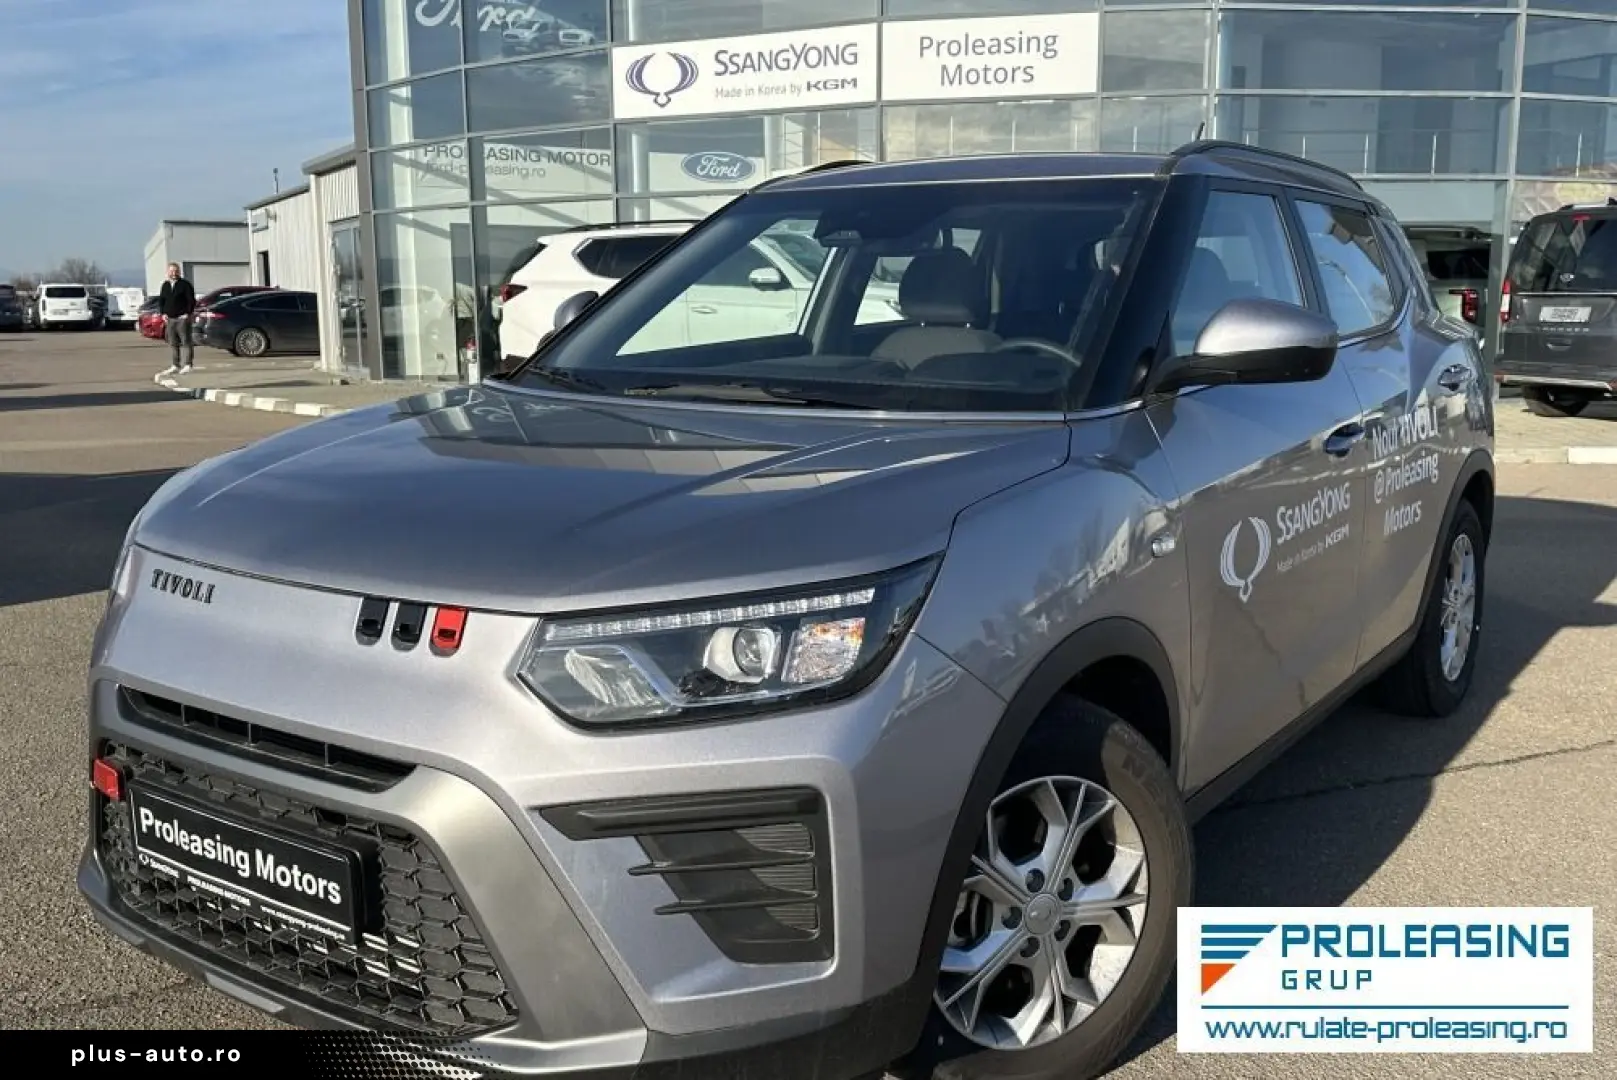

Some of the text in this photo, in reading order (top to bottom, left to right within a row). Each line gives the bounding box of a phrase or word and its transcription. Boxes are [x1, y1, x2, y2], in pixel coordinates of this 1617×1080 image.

[919, 30, 1059, 60] Proleasing
[715, 77, 859, 99] Made in Korea by KGM
[940, 64, 1035, 87] Motors
[696, 154, 742, 178] Ford
[1398, 404, 1438, 447] TIVOLI
[1383, 500, 1422, 537] Motors
[1325, 523, 1351, 549] KGM
[150, 568, 216, 604] TIVOLI
[138, 805, 250, 879] Proleasing
[255, 848, 343, 905] Motors
